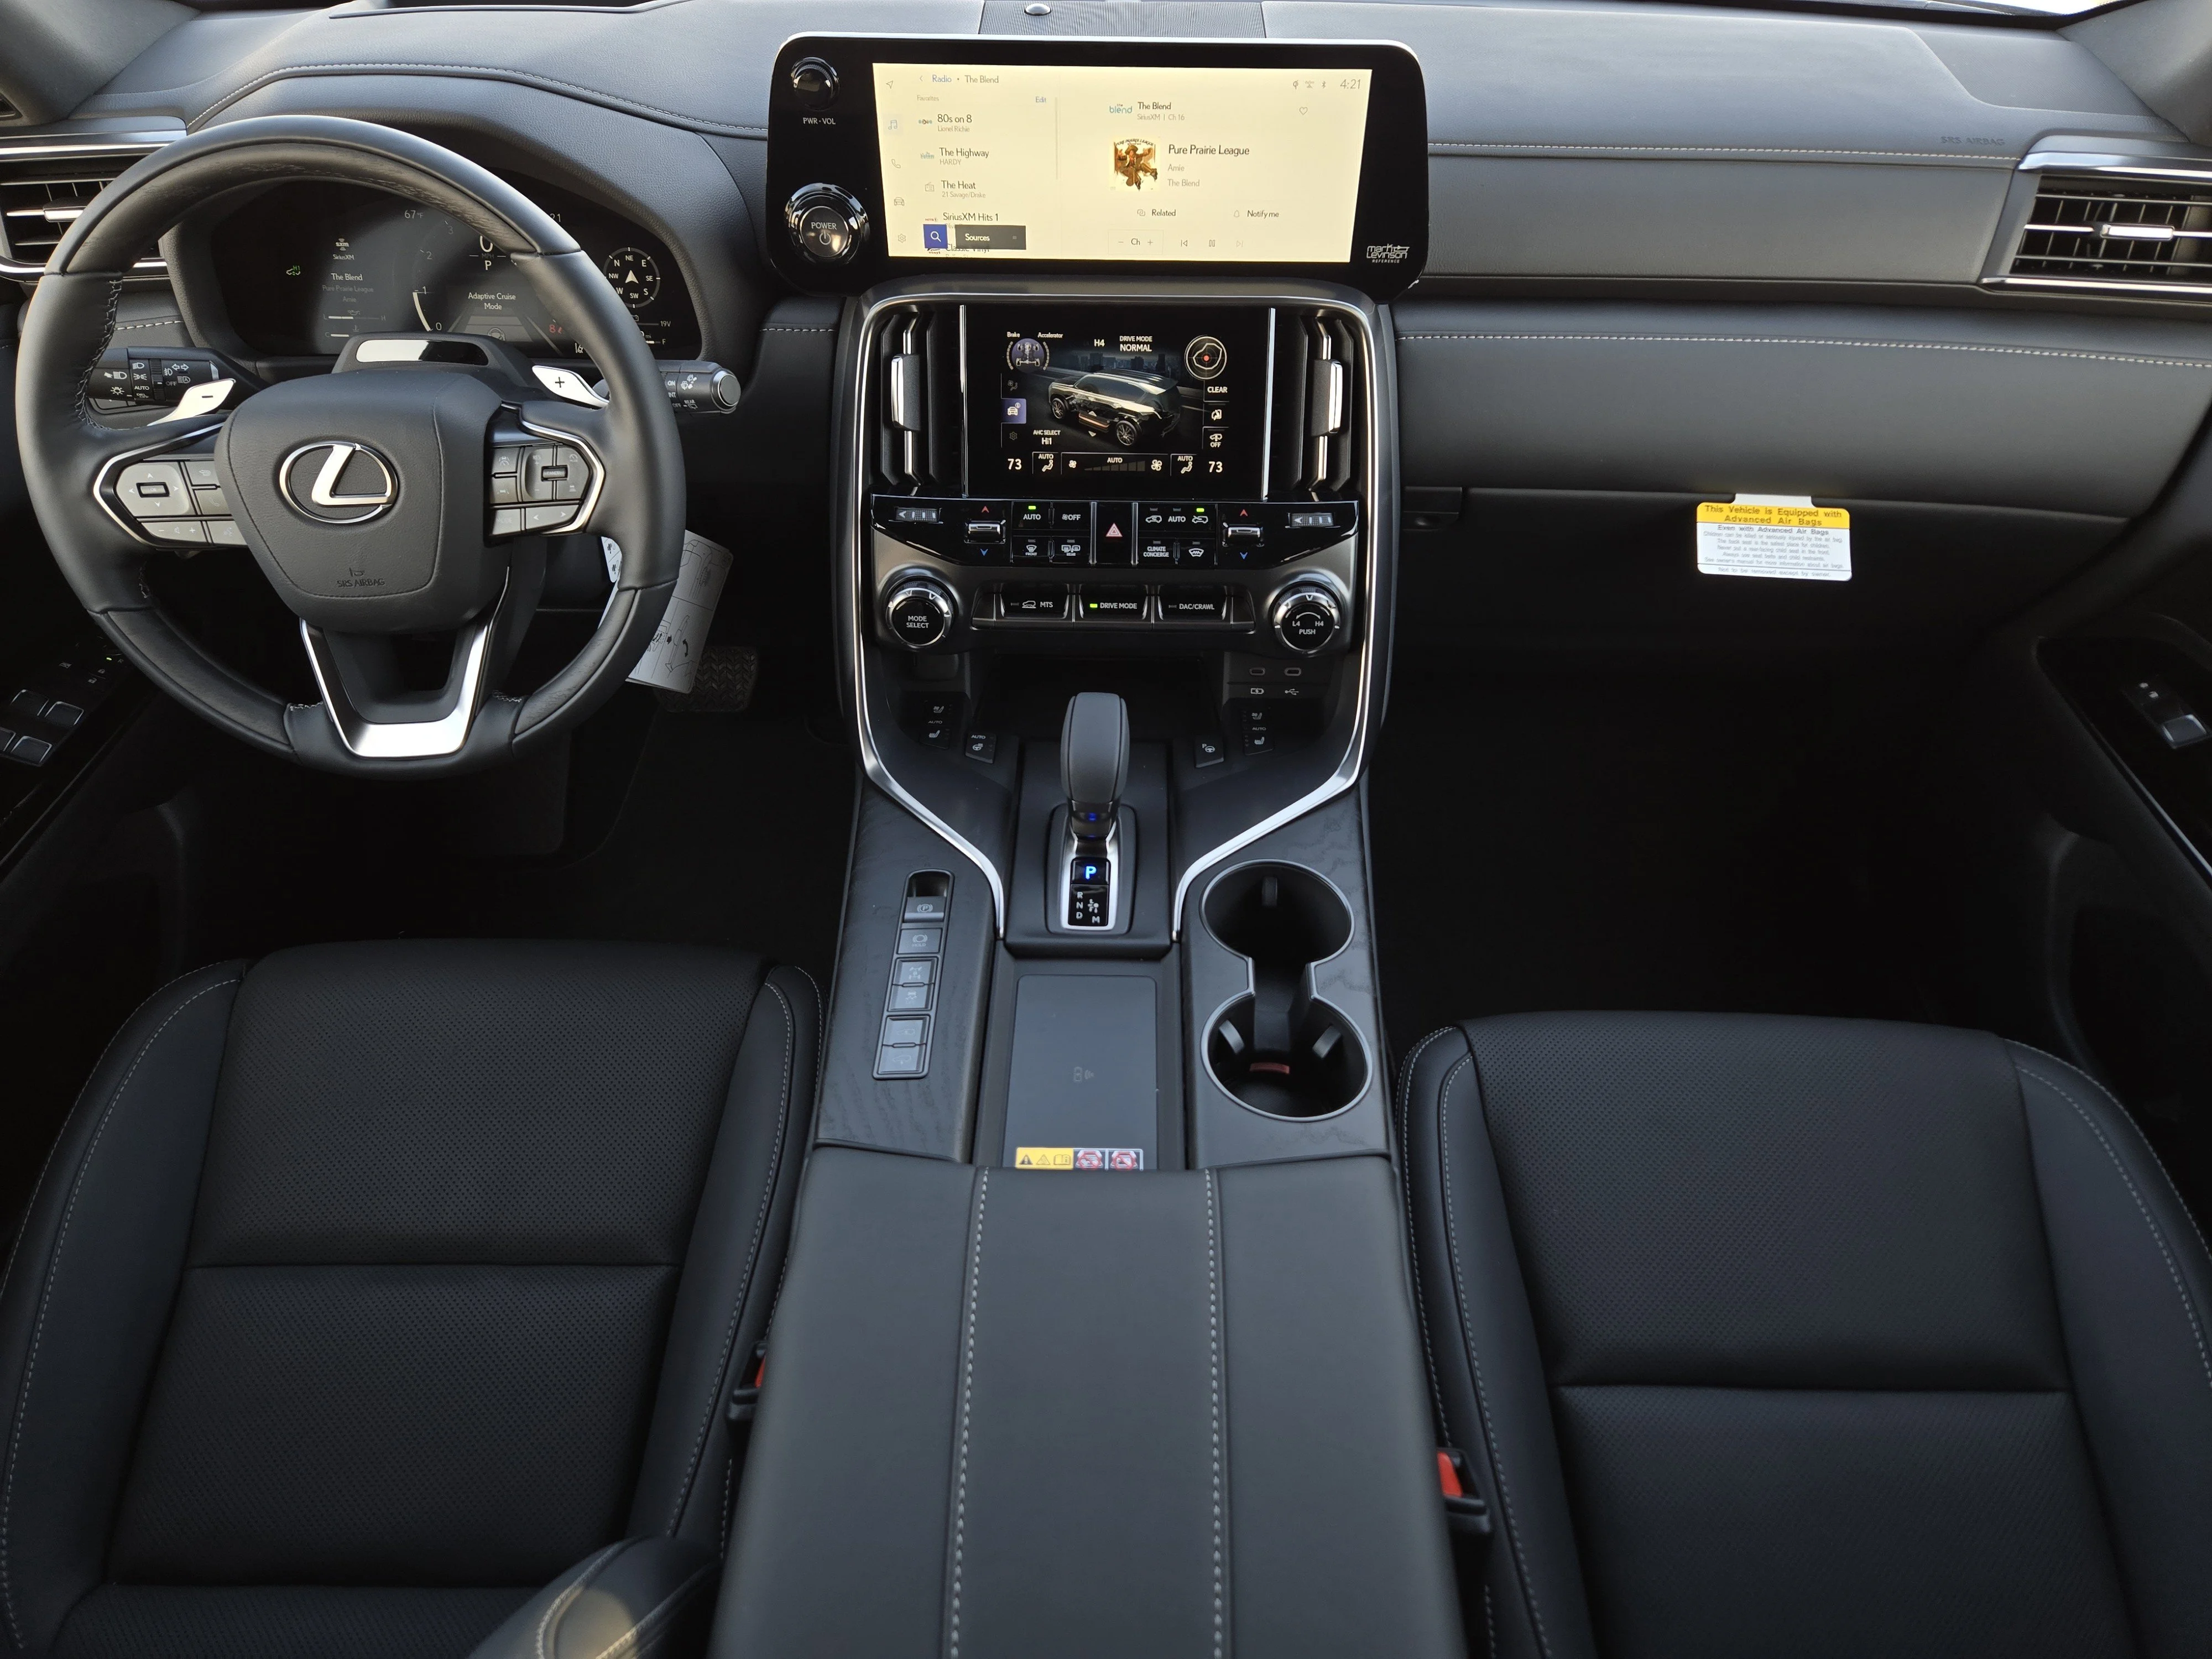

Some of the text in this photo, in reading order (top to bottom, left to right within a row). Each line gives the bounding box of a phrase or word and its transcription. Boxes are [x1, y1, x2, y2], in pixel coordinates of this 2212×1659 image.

[1340, 79, 1360, 89] 4:21
[1109, 105, 1133, 113] blend
[937, 114, 953, 123] 80s
[966, 114, 972, 123] 8
[939, 148, 954, 156] The
[956, 148, 989, 158] Highway
[1168, 145, 1250, 156] Pure Prairie League
[941, 180, 975, 189] The Heat
[943, 212, 976, 221] SiriusXM
[978, 213, 993, 221] Hits
[1247, 210, 1268, 218] Notify
[448, 226, 453, 234] 3
[427, 252, 432, 260] 2
[484, 260, 492, 270] P
[468, 293, 495, 301] Adaptive
[436, 322, 441, 331] 0
[1008, 458, 1022, 470] 73
[1208, 461, 1223, 473] 73
[1728, 505, 1760, 514] Vehicle
[1778, 508, 1818, 517] Equipped
[1724, 515, 1771, 524] Advanced
[354, 578, 385, 587] AIRBAG
[1084, 865, 1097, 880] P
